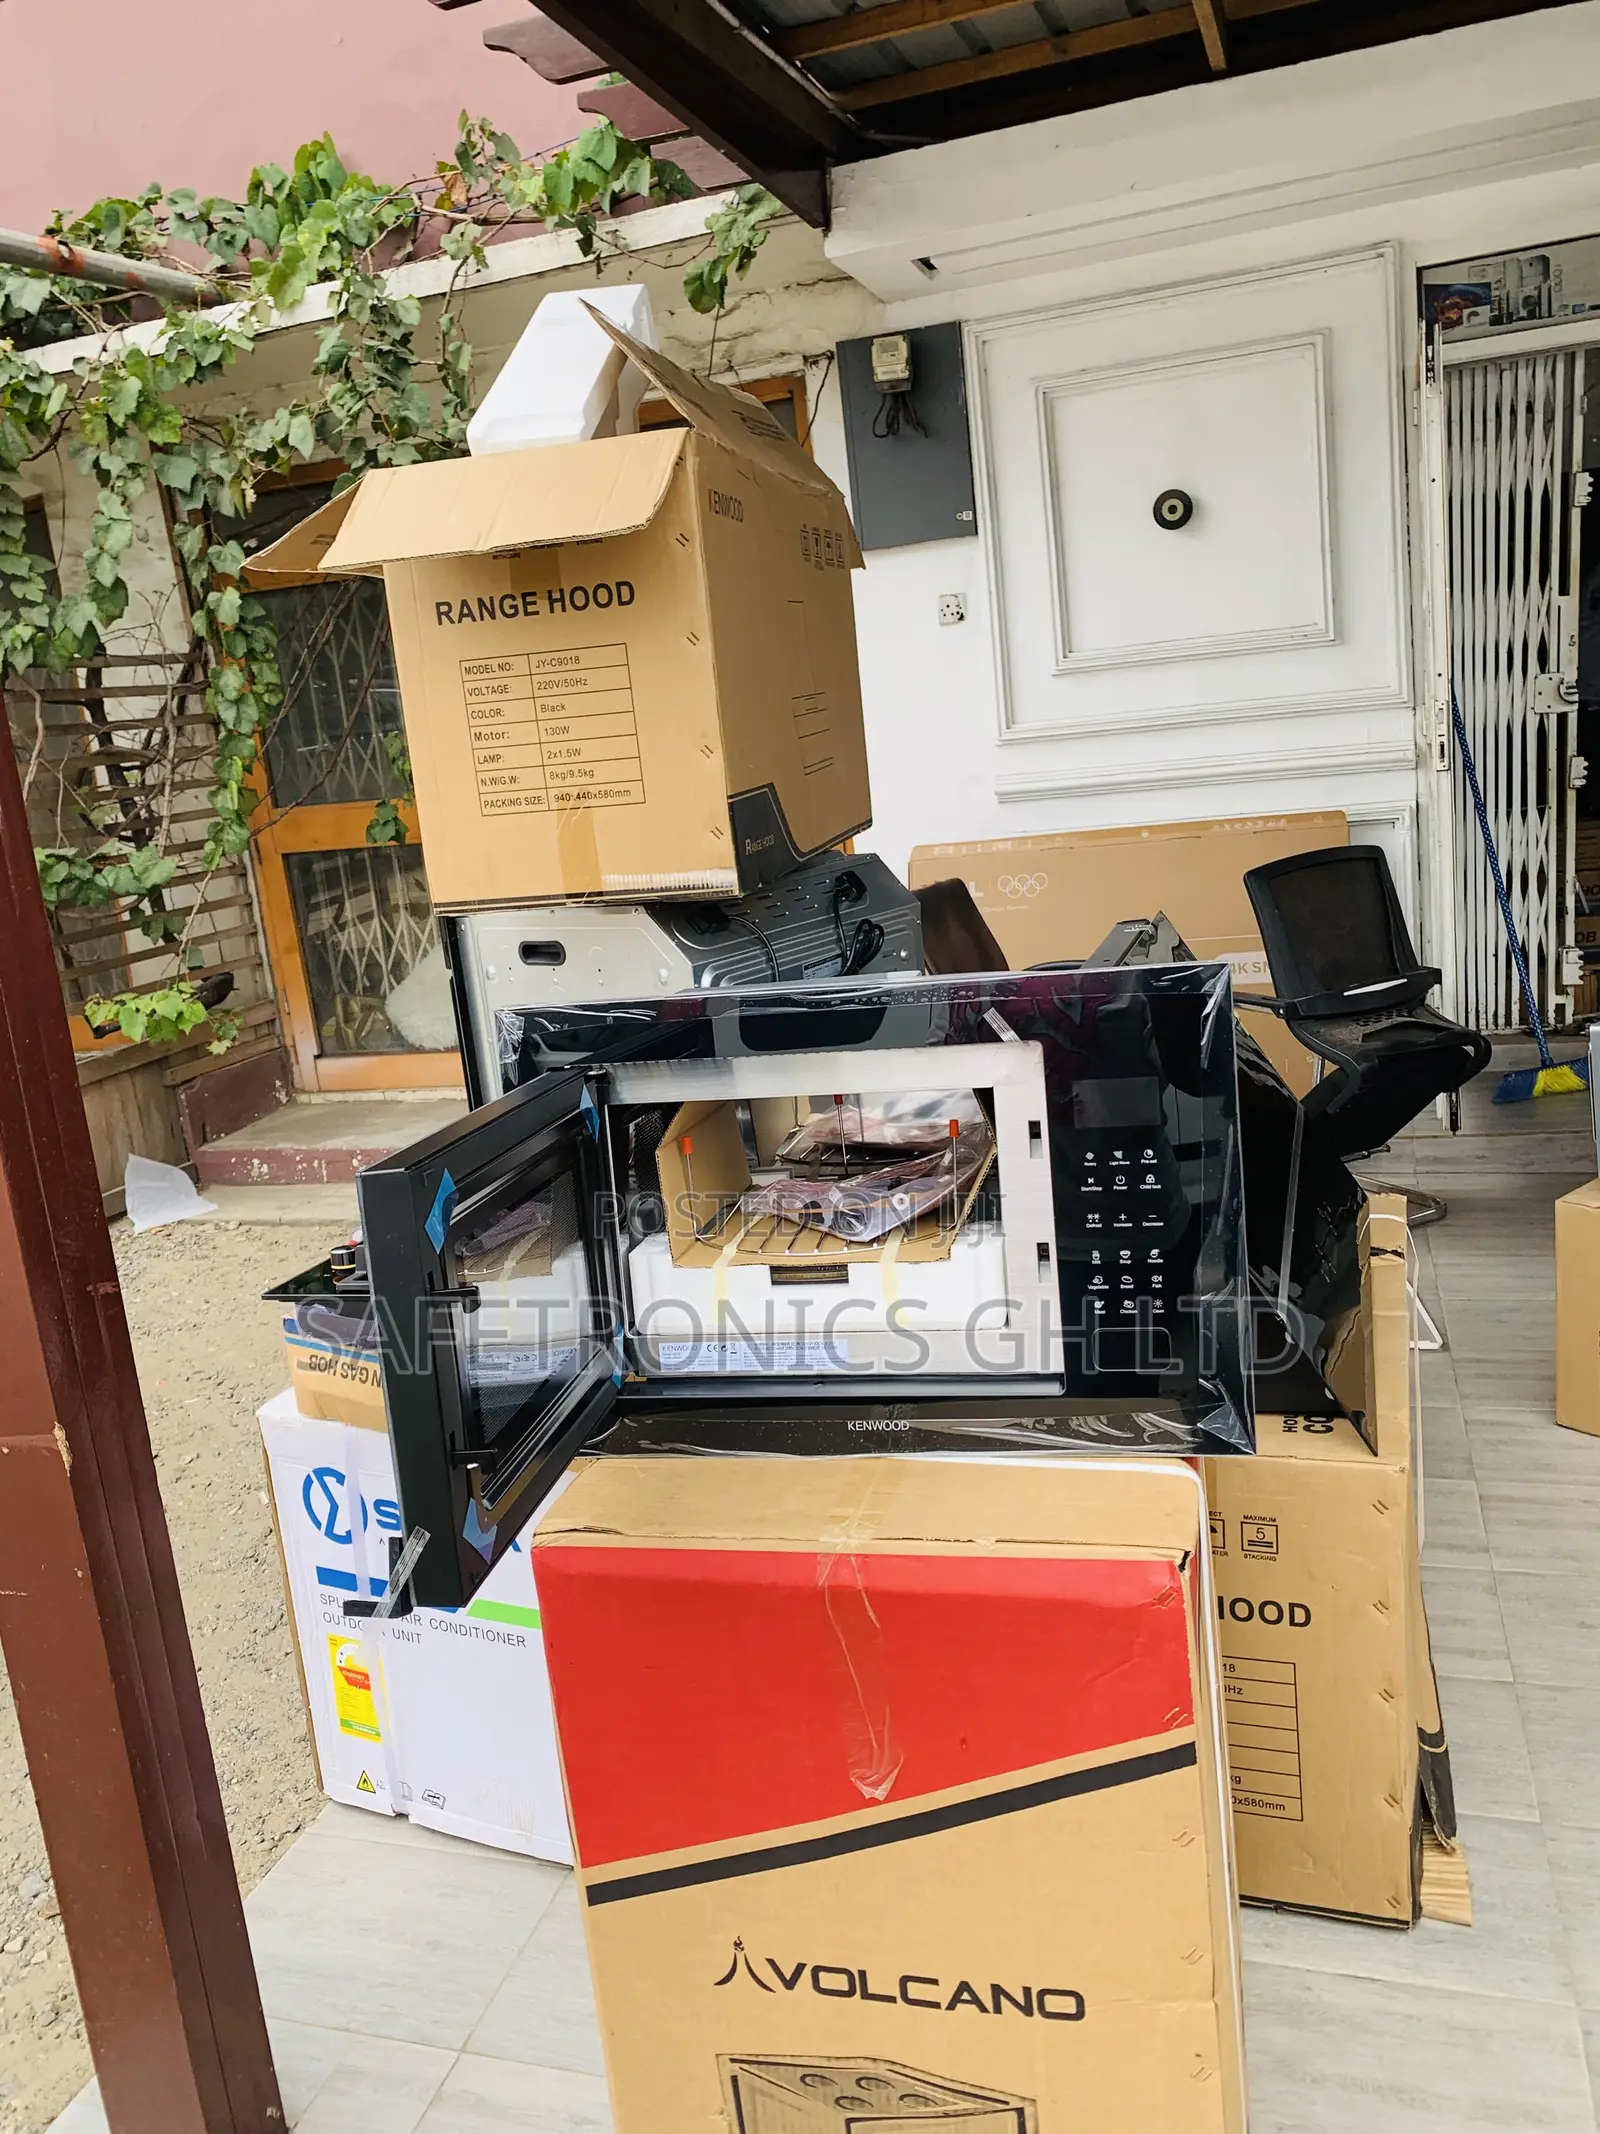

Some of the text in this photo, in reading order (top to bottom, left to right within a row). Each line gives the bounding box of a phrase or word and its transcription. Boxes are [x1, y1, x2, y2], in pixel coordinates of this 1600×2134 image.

[708, 488, 744, 523] KENWOOD
[435, 580, 635, 626] RANGE HOOD
[464, 662, 514, 675] MODEL NO:
[535, 656, 580, 669] JY-C9018
[467, 684, 512, 697] VOLTAGE:
[536, 677, 588, 691] 220V/50Hz
[470, 708, 505, 720] COLOR:
[540, 702, 566, 713] Black
[473, 730, 510, 742] Motor:
[544, 725, 570, 736] 130W
[477, 753, 505, 765] LAMP:
[546, 748, 581, 760] 2x1.5W
[549, 768, 595, 781] 8kg/9.5kg
[483, 796, 546, 809] PACKING SIZE:
[662, 1344, 698, 1352] KENWOOD
[308, 1353, 338, 1377] HOB
[340, 1361, 370, 1385] GAS
[847, 1420, 910, 1431] KENWOOD
[1243, 1514, 1277, 1523] MAXIMUM
[1255, 1527, 1266, 1541] 5
[1212, 1549, 1229, 1557] ATER
[1243, 1552, 1277, 1562] STACKING
[392, 1627, 423, 1645] UNIT
[429, 1617, 527, 1649] CONDITIONER
[765, 1957, 1086, 2022] VOLCANO
